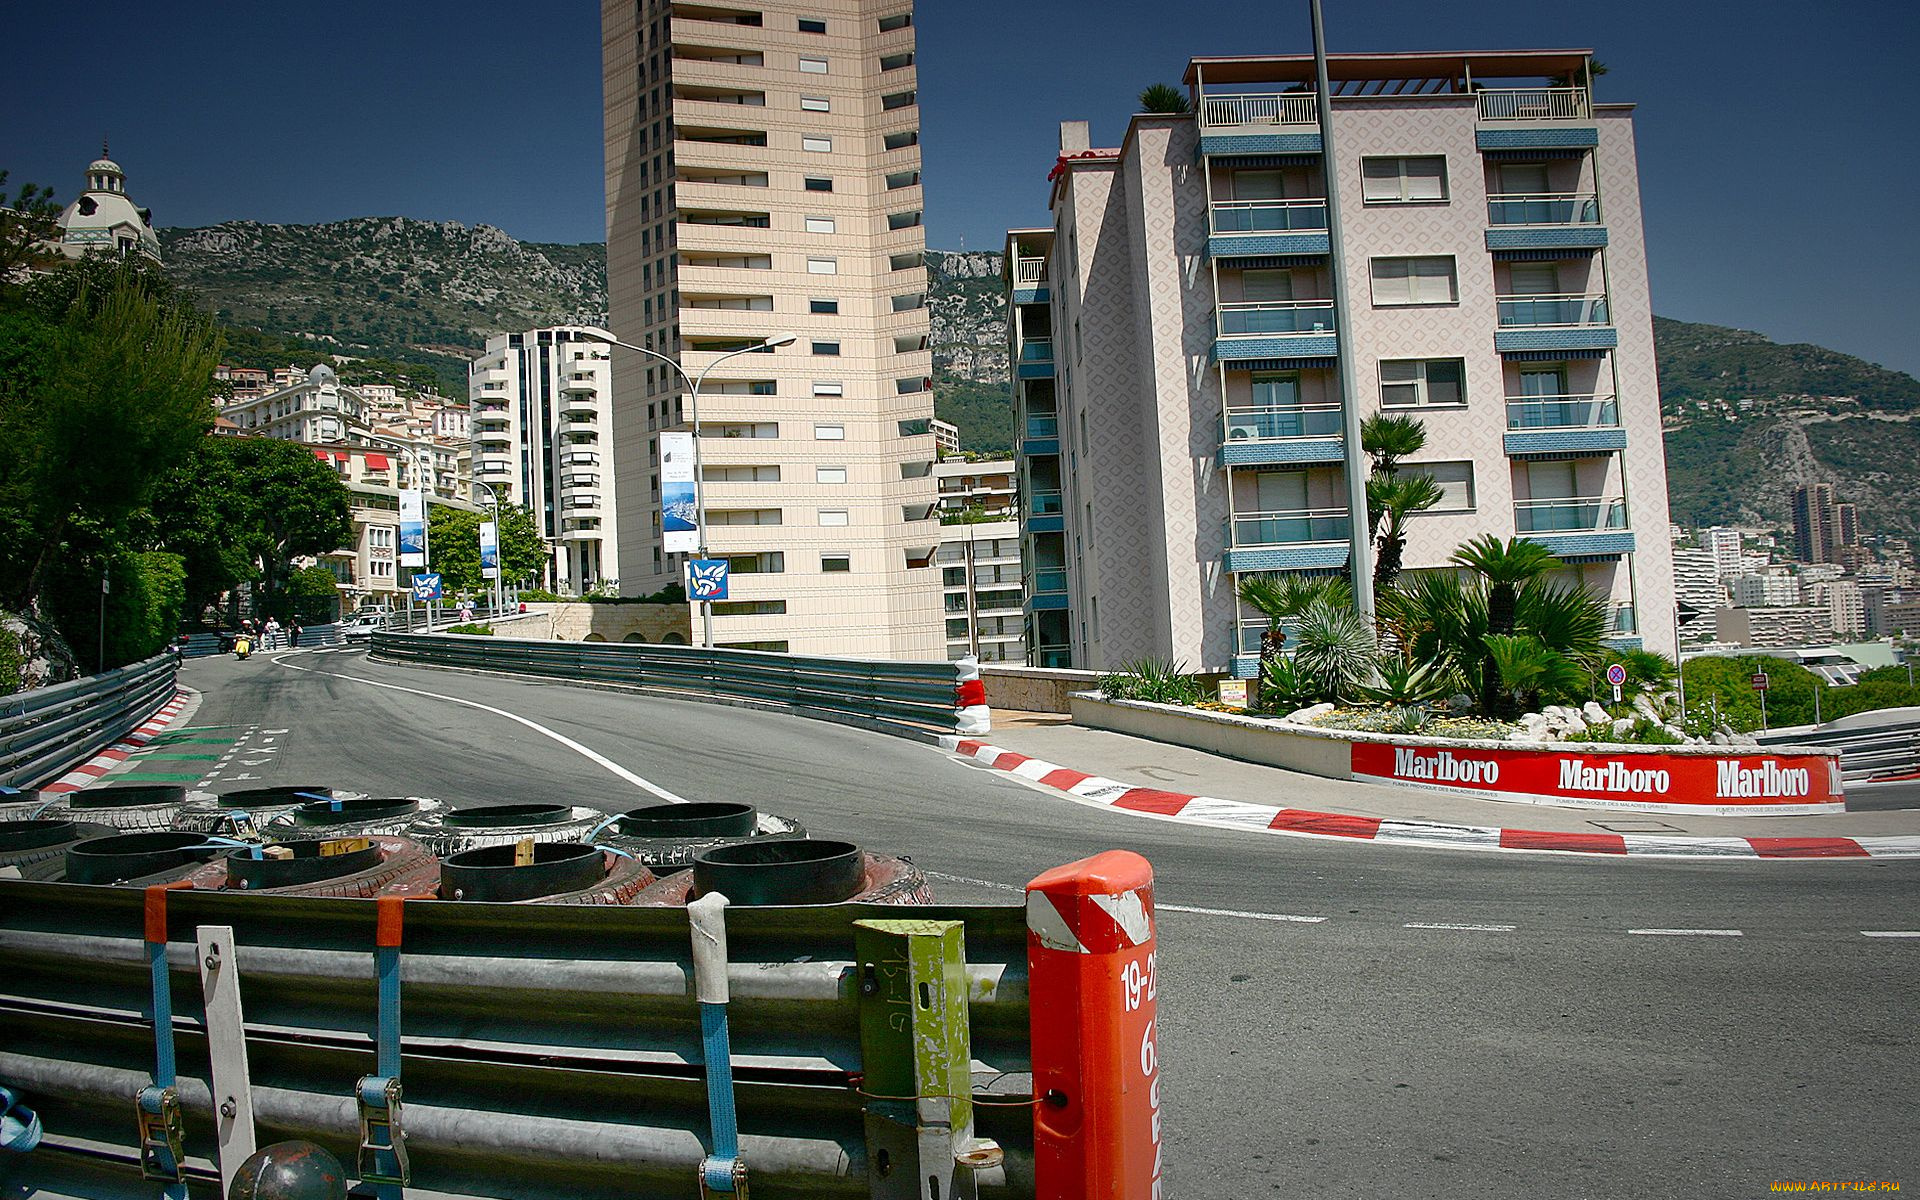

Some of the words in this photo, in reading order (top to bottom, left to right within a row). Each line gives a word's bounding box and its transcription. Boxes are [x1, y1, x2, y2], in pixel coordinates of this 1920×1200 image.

[1393, 748, 1499, 784] Marlboro
[1557, 759, 1670, 794] Marlboro
[1716, 760, 1809, 797] Marlboro
[1121, 949, 1158, 1012] 19-2
